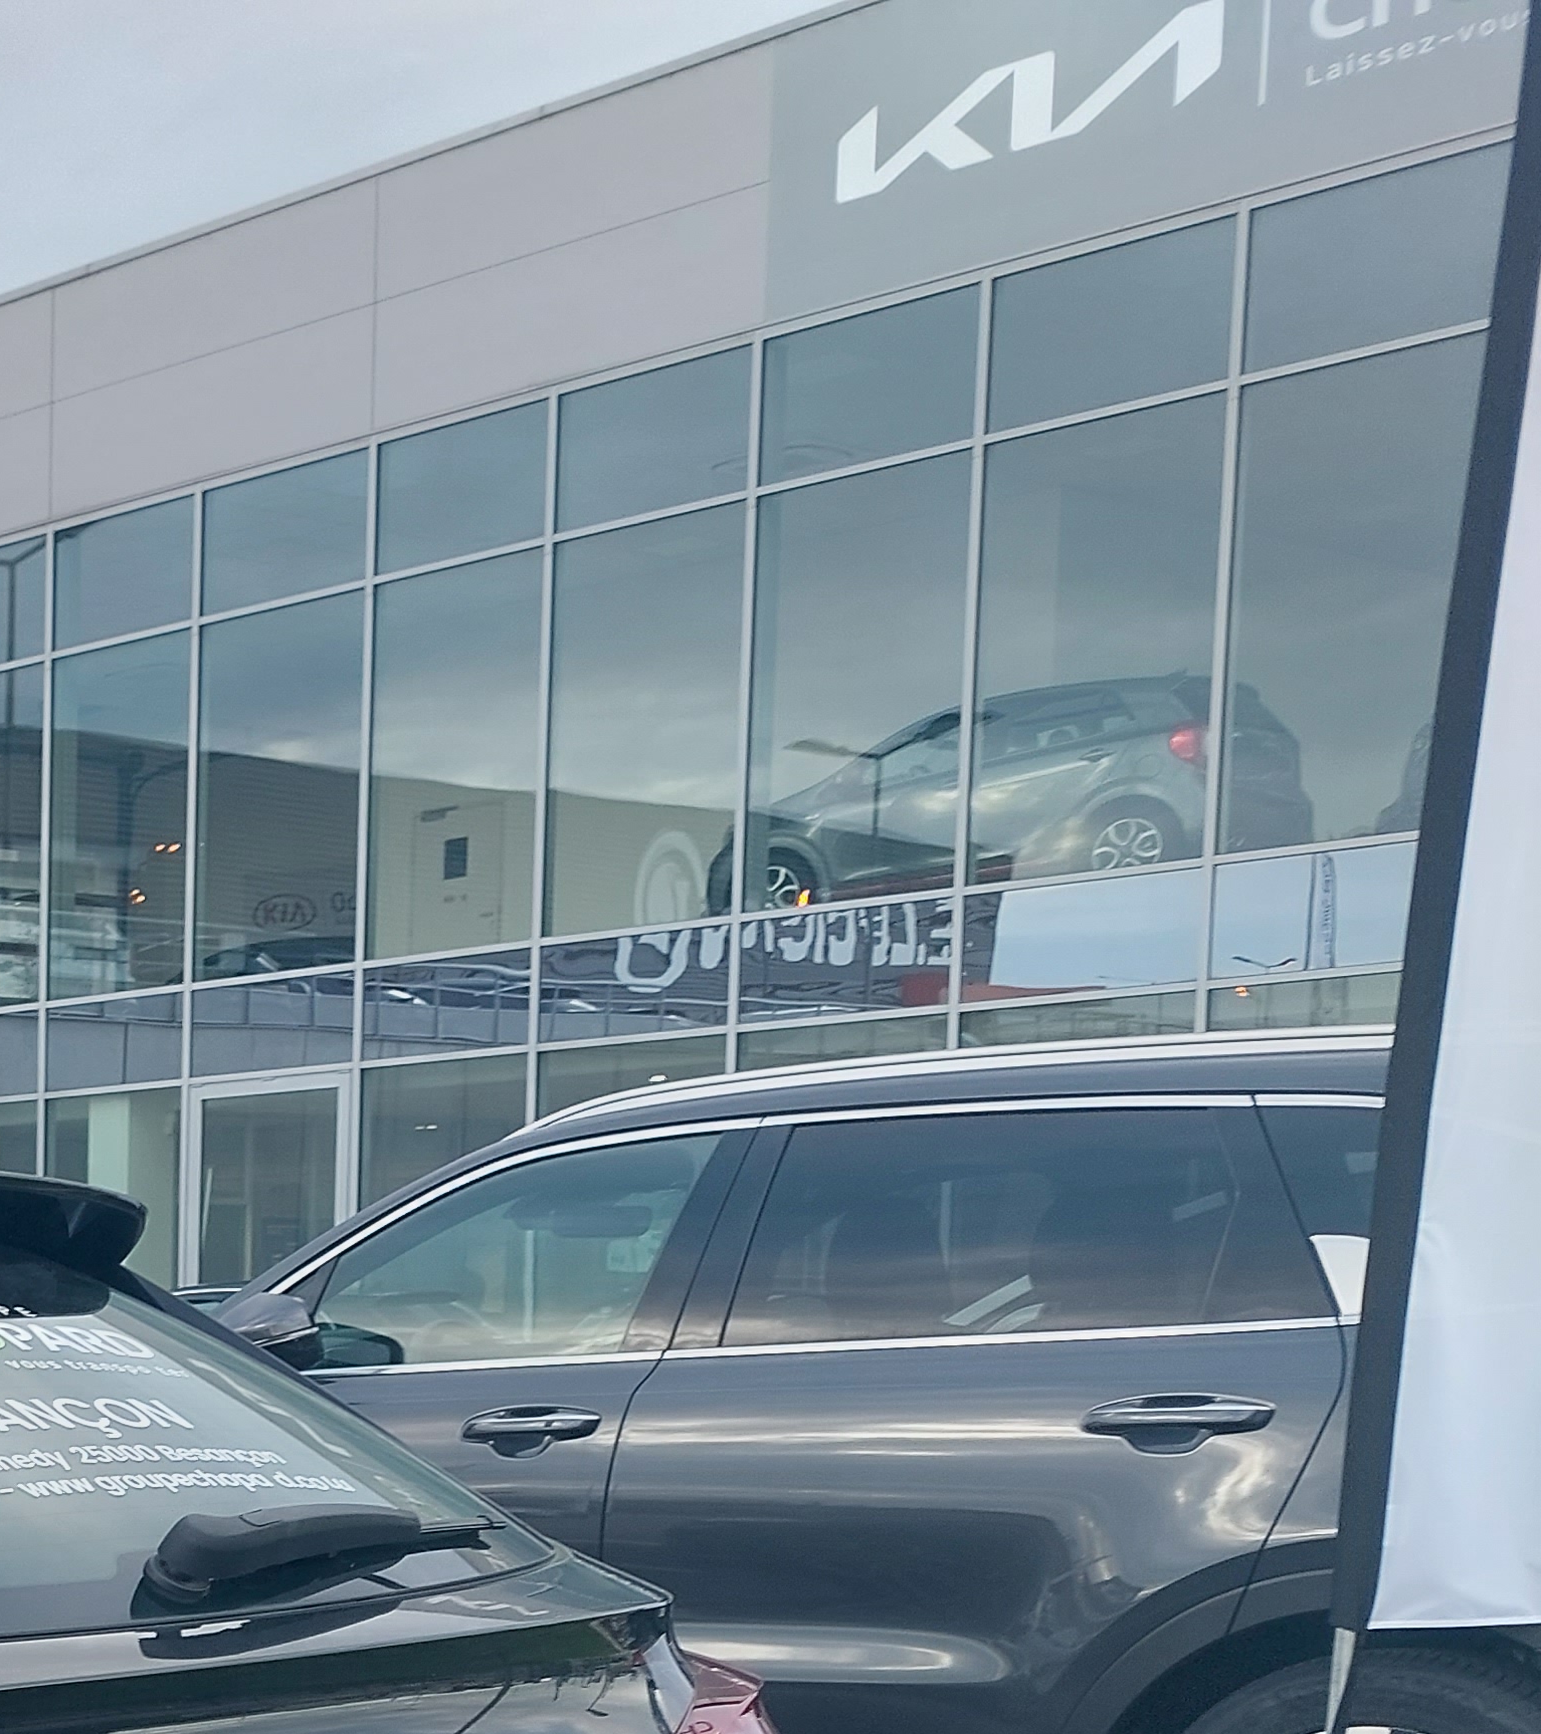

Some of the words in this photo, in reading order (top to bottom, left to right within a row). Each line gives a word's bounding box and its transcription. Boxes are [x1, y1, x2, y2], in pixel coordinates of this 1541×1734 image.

[835, 0, 1224, 204] KIA
[68, 1444, 161, 1465] 25000
[156, 1445, 288, 1469] Besançon
